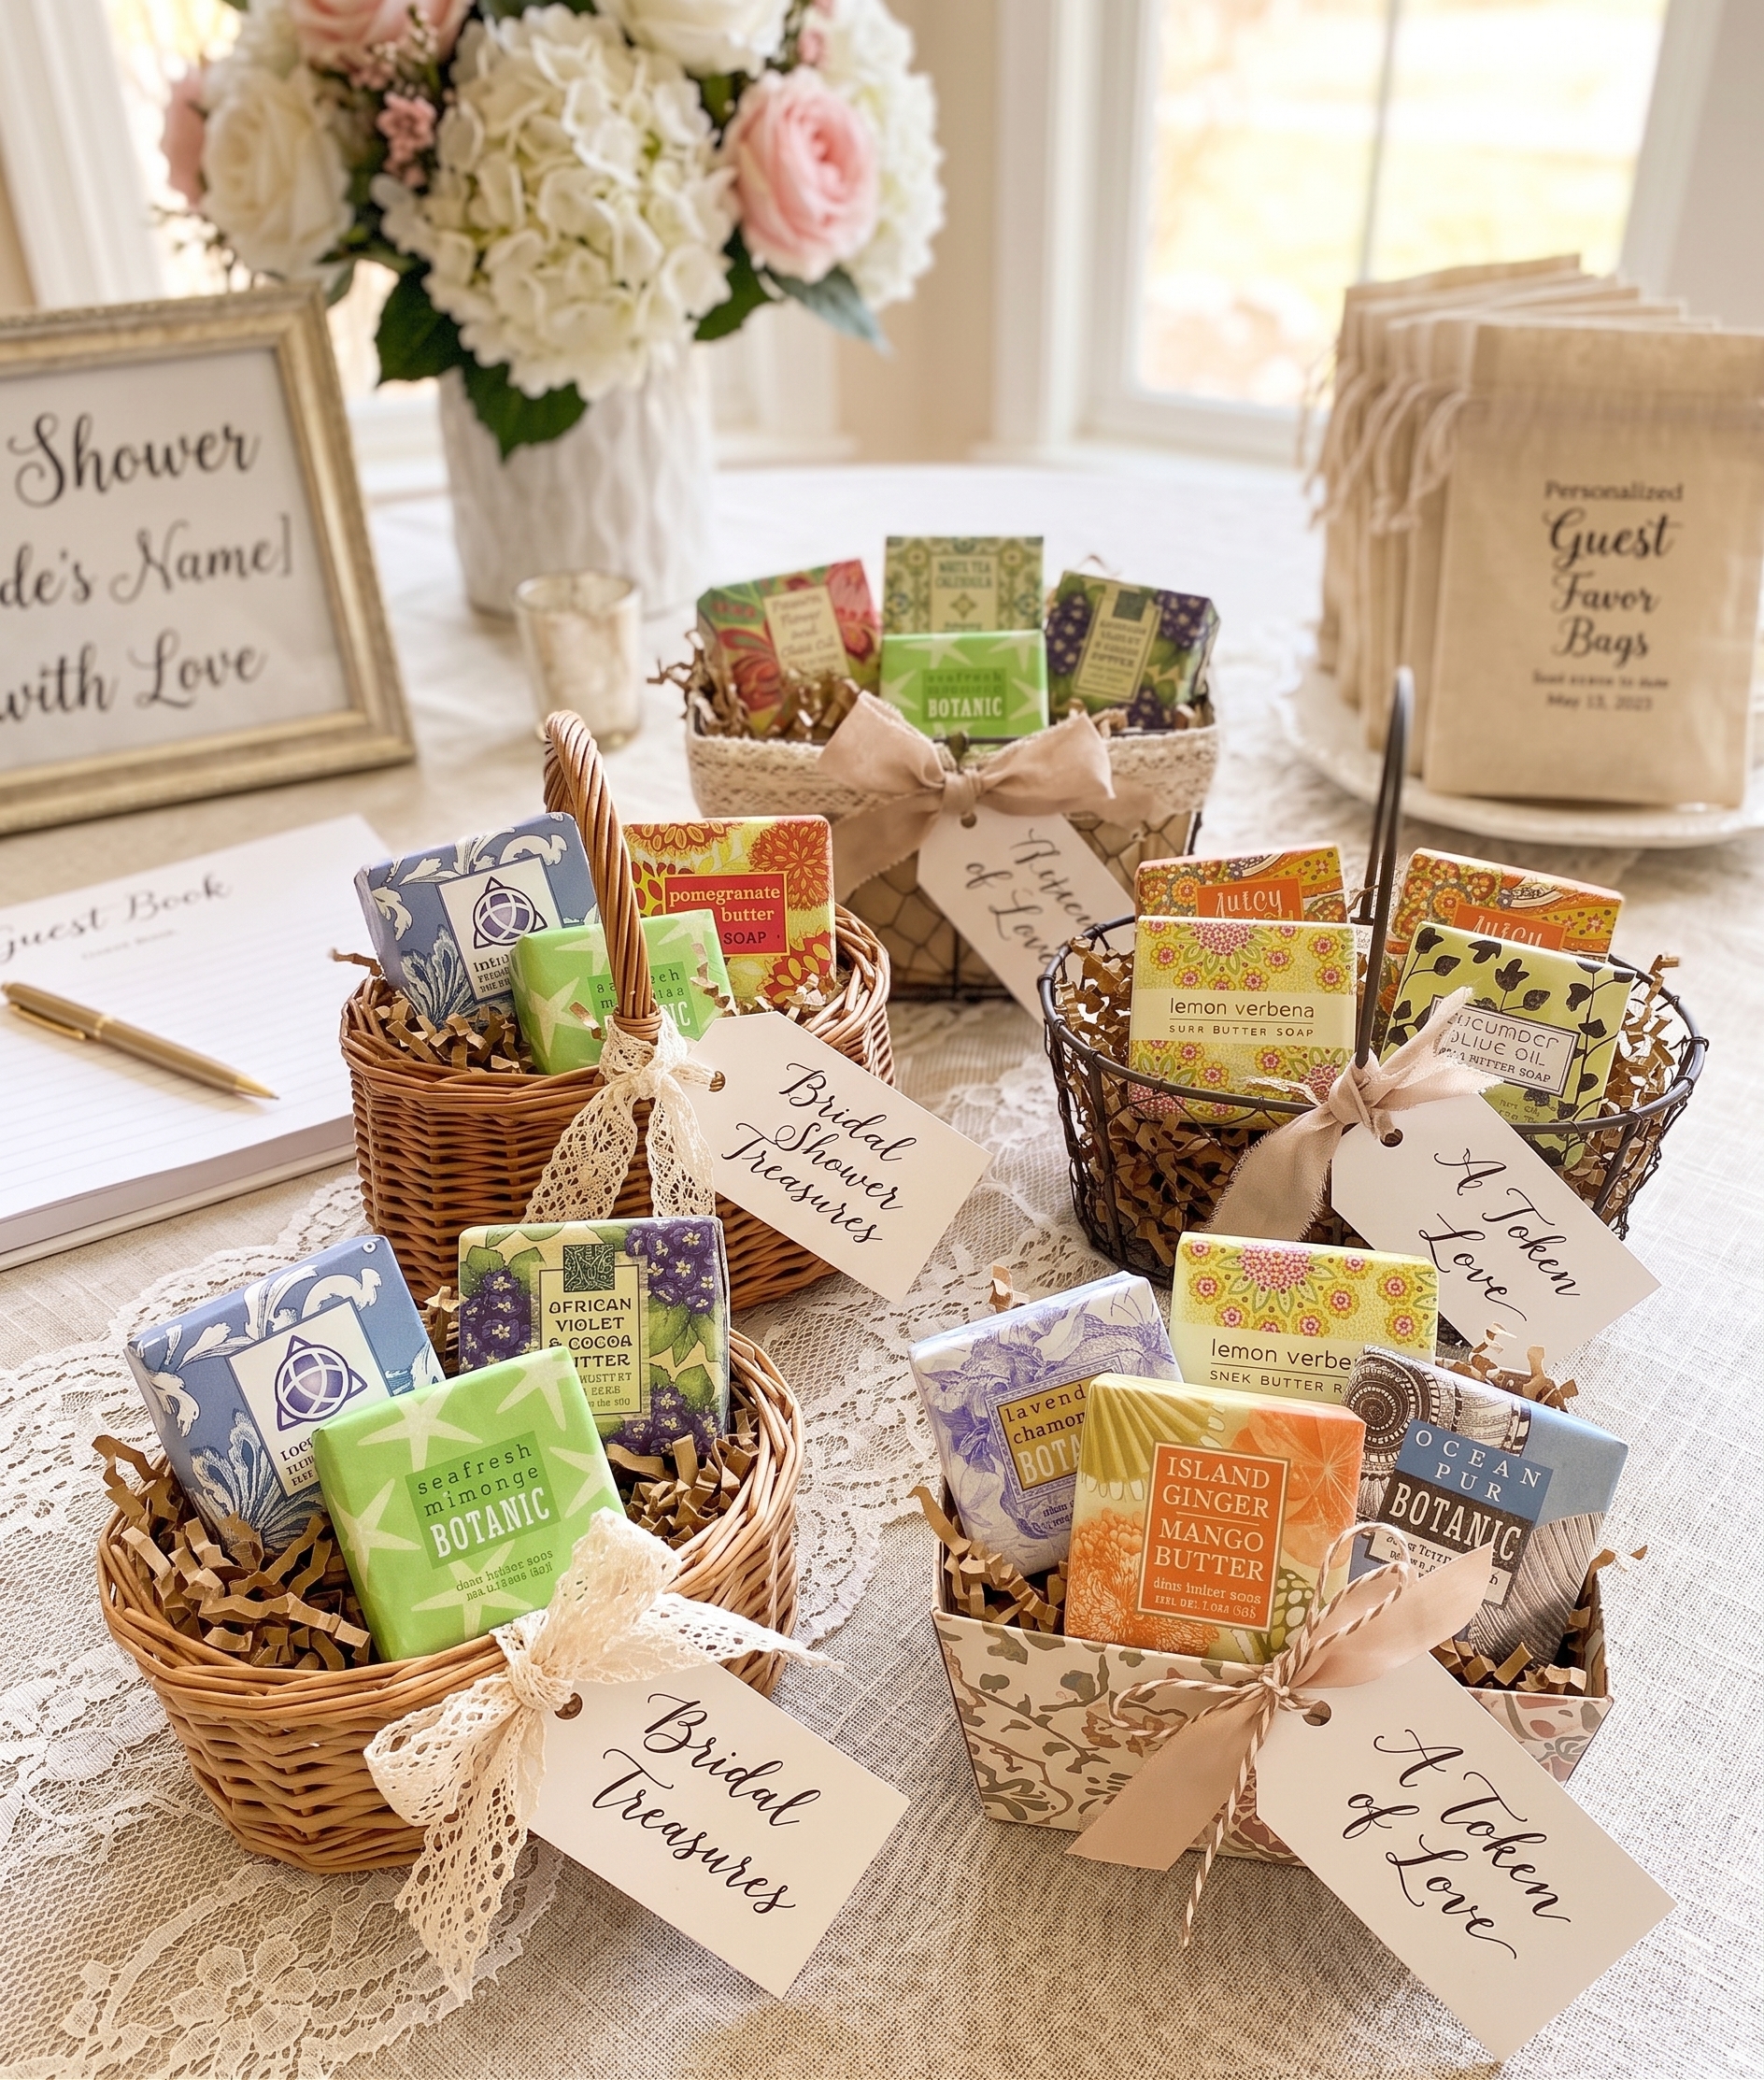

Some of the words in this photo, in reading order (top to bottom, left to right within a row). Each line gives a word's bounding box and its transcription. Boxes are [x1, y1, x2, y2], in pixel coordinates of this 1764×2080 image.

[7, 412, 262, 508] Shower
[1542, 506, 1684, 572] Guest
[1550, 571, 1661, 614] Favor
[1550, 614, 1649, 670] Bags
[0, 642, 119, 723] with
[127, 628, 269, 709] Love
[928, 696, 1003, 719] BOTANIC
[125, 871, 231, 922] Book
[669, 886, 781, 908] pomegranate
[965, 862, 1014, 890] of
[720, 906, 775, 922] butter
[723, 931, 768, 946] SOAP
[1169, 1025, 1204, 1033] SURR
[1213, 1025, 1267, 1036] BUTTER
[1276, 1027, 1314, 1037] SOAP
[1170, 997, 1227, 1016] lemon
[1235, 1000, 1315, 1019] verbena
[1518, 1067, 1551, 1083] SOAP
[778, 1062, 918, 1161] Bridal
[721, 1122, 883, 1244] Treasures
[775, 1121, 903, 1210] Shower
[1433, 1147, 1507, 1196] A
[1481, 1188, 1581, 1296] Token
[1417, 1213, 1528, 1322] Love
[555, 1317, 625, 1333] VIOLET
[568, 1334, 633, 1351] COCOA
[1212, 1338, 1277, 1363] lemon
[1004, 1383, 1087, 1423] lavend
[1209, 1370, 1251, 1384] SNEK
[1260, 1375, 1324, 1392] BUTTER
[418, 1444, 532, 1495] seafresh
[1167, 1456, 1271, 1489] ISLAND
[1415, 1429, 1542, 1489] OCEAN
[1434, 1461, 1503, 1503] PUR
[423, 1466, 539, 1517] mimonge
[1162, 1484, 1270, 1519] GINGER
[430, 1487, 550, 1559] BOTANIC
[1159, 1517, 1264, 1553] MANGO
[1388, 1482, 1523, 1562] BOTANIC
[1154, 1545, 1264, 1582] BUTTER
[643, 1693, 821, 1826] Bridal
[592, 1748, 796, 1914] Treasures
[1373, 1729, 1464, 1788] A
[1440, 1771, 1572, 1923] Token
[1343, 1793, 1420, 1840] of
[1386, 1833, 1517, 1960] Love
